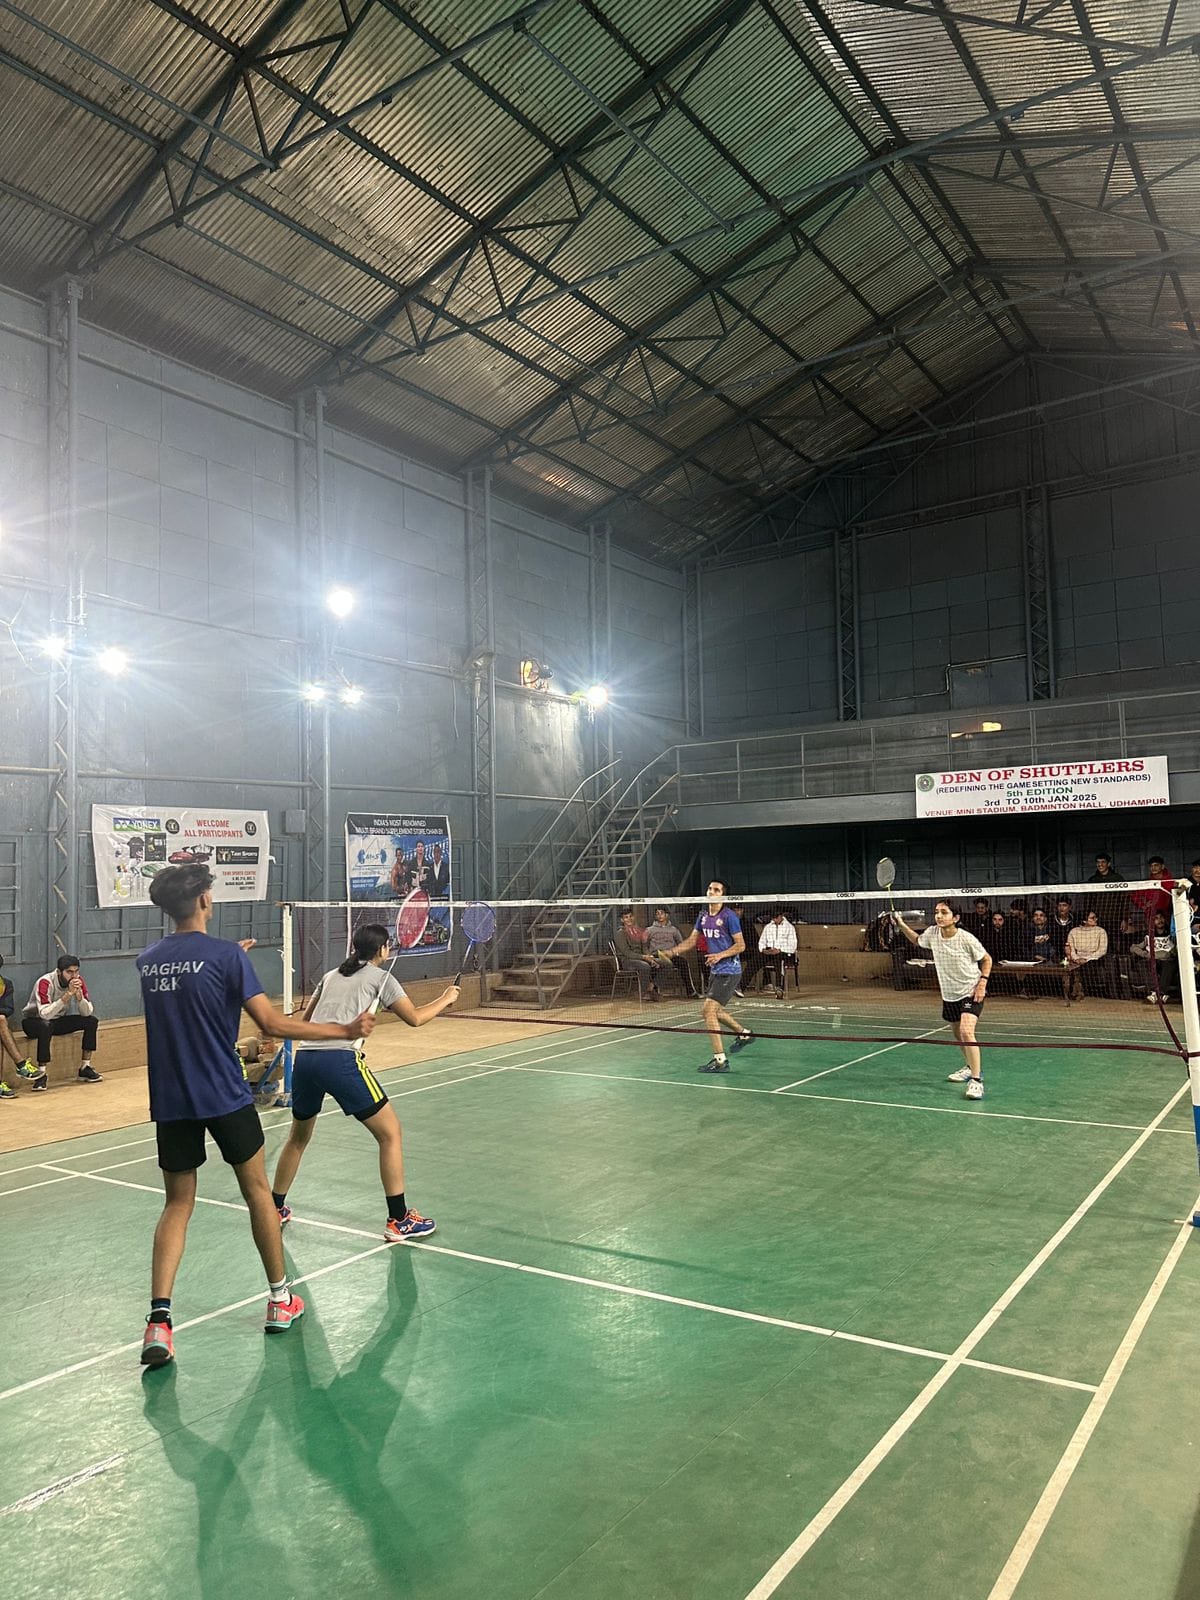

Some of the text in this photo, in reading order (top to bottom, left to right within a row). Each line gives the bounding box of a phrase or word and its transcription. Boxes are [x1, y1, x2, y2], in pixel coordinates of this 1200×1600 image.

[940, 760, 1145, 784] DEN OF SHUTTLERS
[936, 773, 1151, 795] (REDEFINING THE GAME SETTING NEW STANDARDS)
[1026, 786, 1073, 796] EDITION
[984, 799, 1000, 807] 3rd
[1023, 796, 1045, 804] 10th
[1047, 795, 1069, 803] JAN
[1072, 793, 1097, 802] 2025
[1020, 803, 1076, 812] BADMINTON
[1079, 801, 1107, 809] HALL,
[1109, 798, 1167, 807] UDHAMPUR
[196, 819, 230, 828] WELCOME
[184, 829, 243, 838] ALL PARTICIPANTS
[142, 961, 205, 977] RAGHAV
[149, 976, 183, 992] J&K
